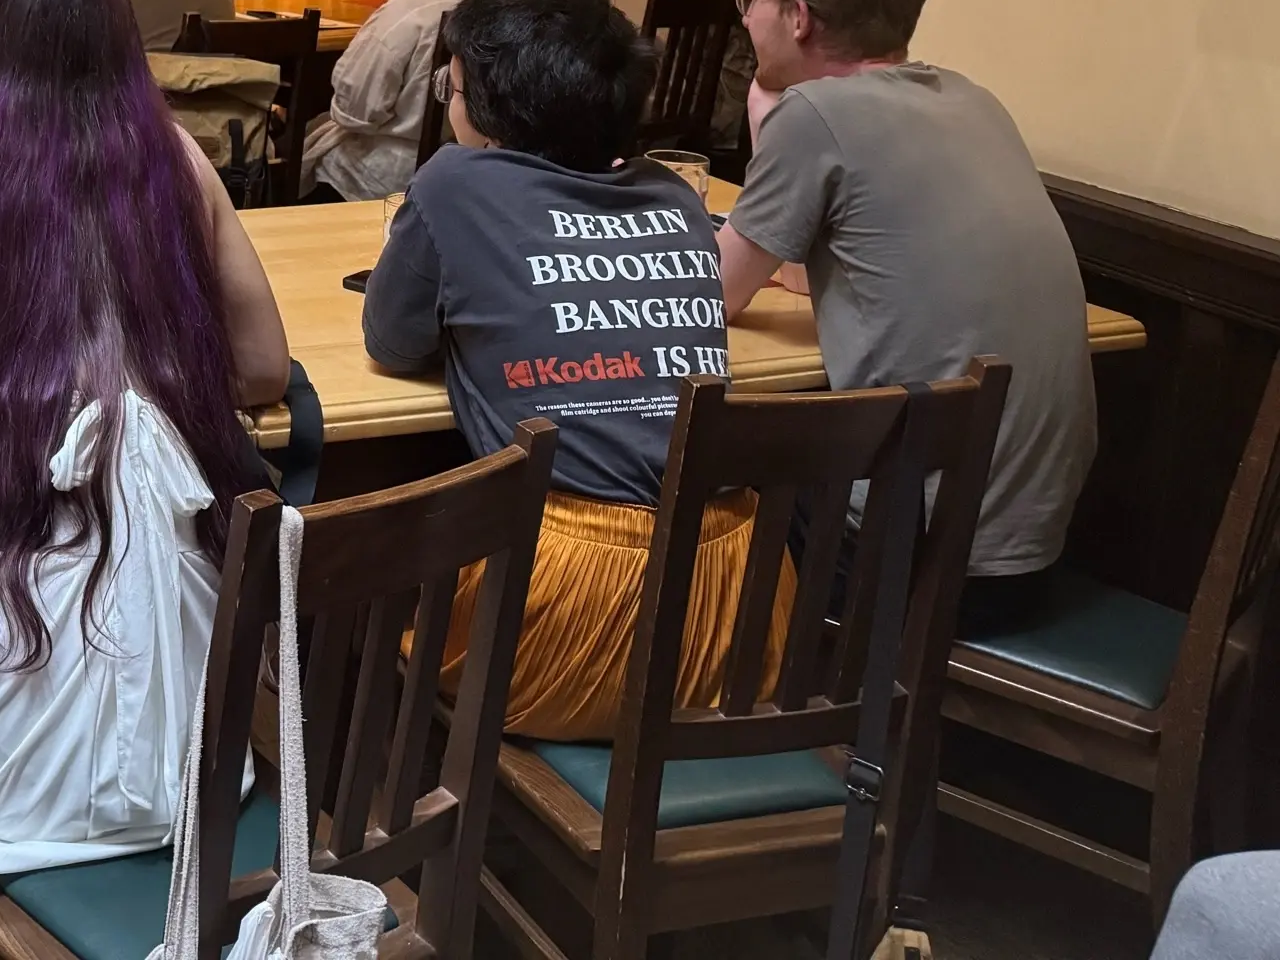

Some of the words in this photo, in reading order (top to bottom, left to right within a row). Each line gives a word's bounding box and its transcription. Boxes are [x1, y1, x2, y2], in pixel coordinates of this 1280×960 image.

[548, 209, 689, 239] BERLIN
[526, 250, 721, 285] BROOKLYN
[551, 297, 725, 333] BANGKOK
[535, 351, 645, 384] Kodak
[652, 345, 690, 377] IS
[693, 346, 732, 378] HE
[629, 403, 657, 411] colourful
